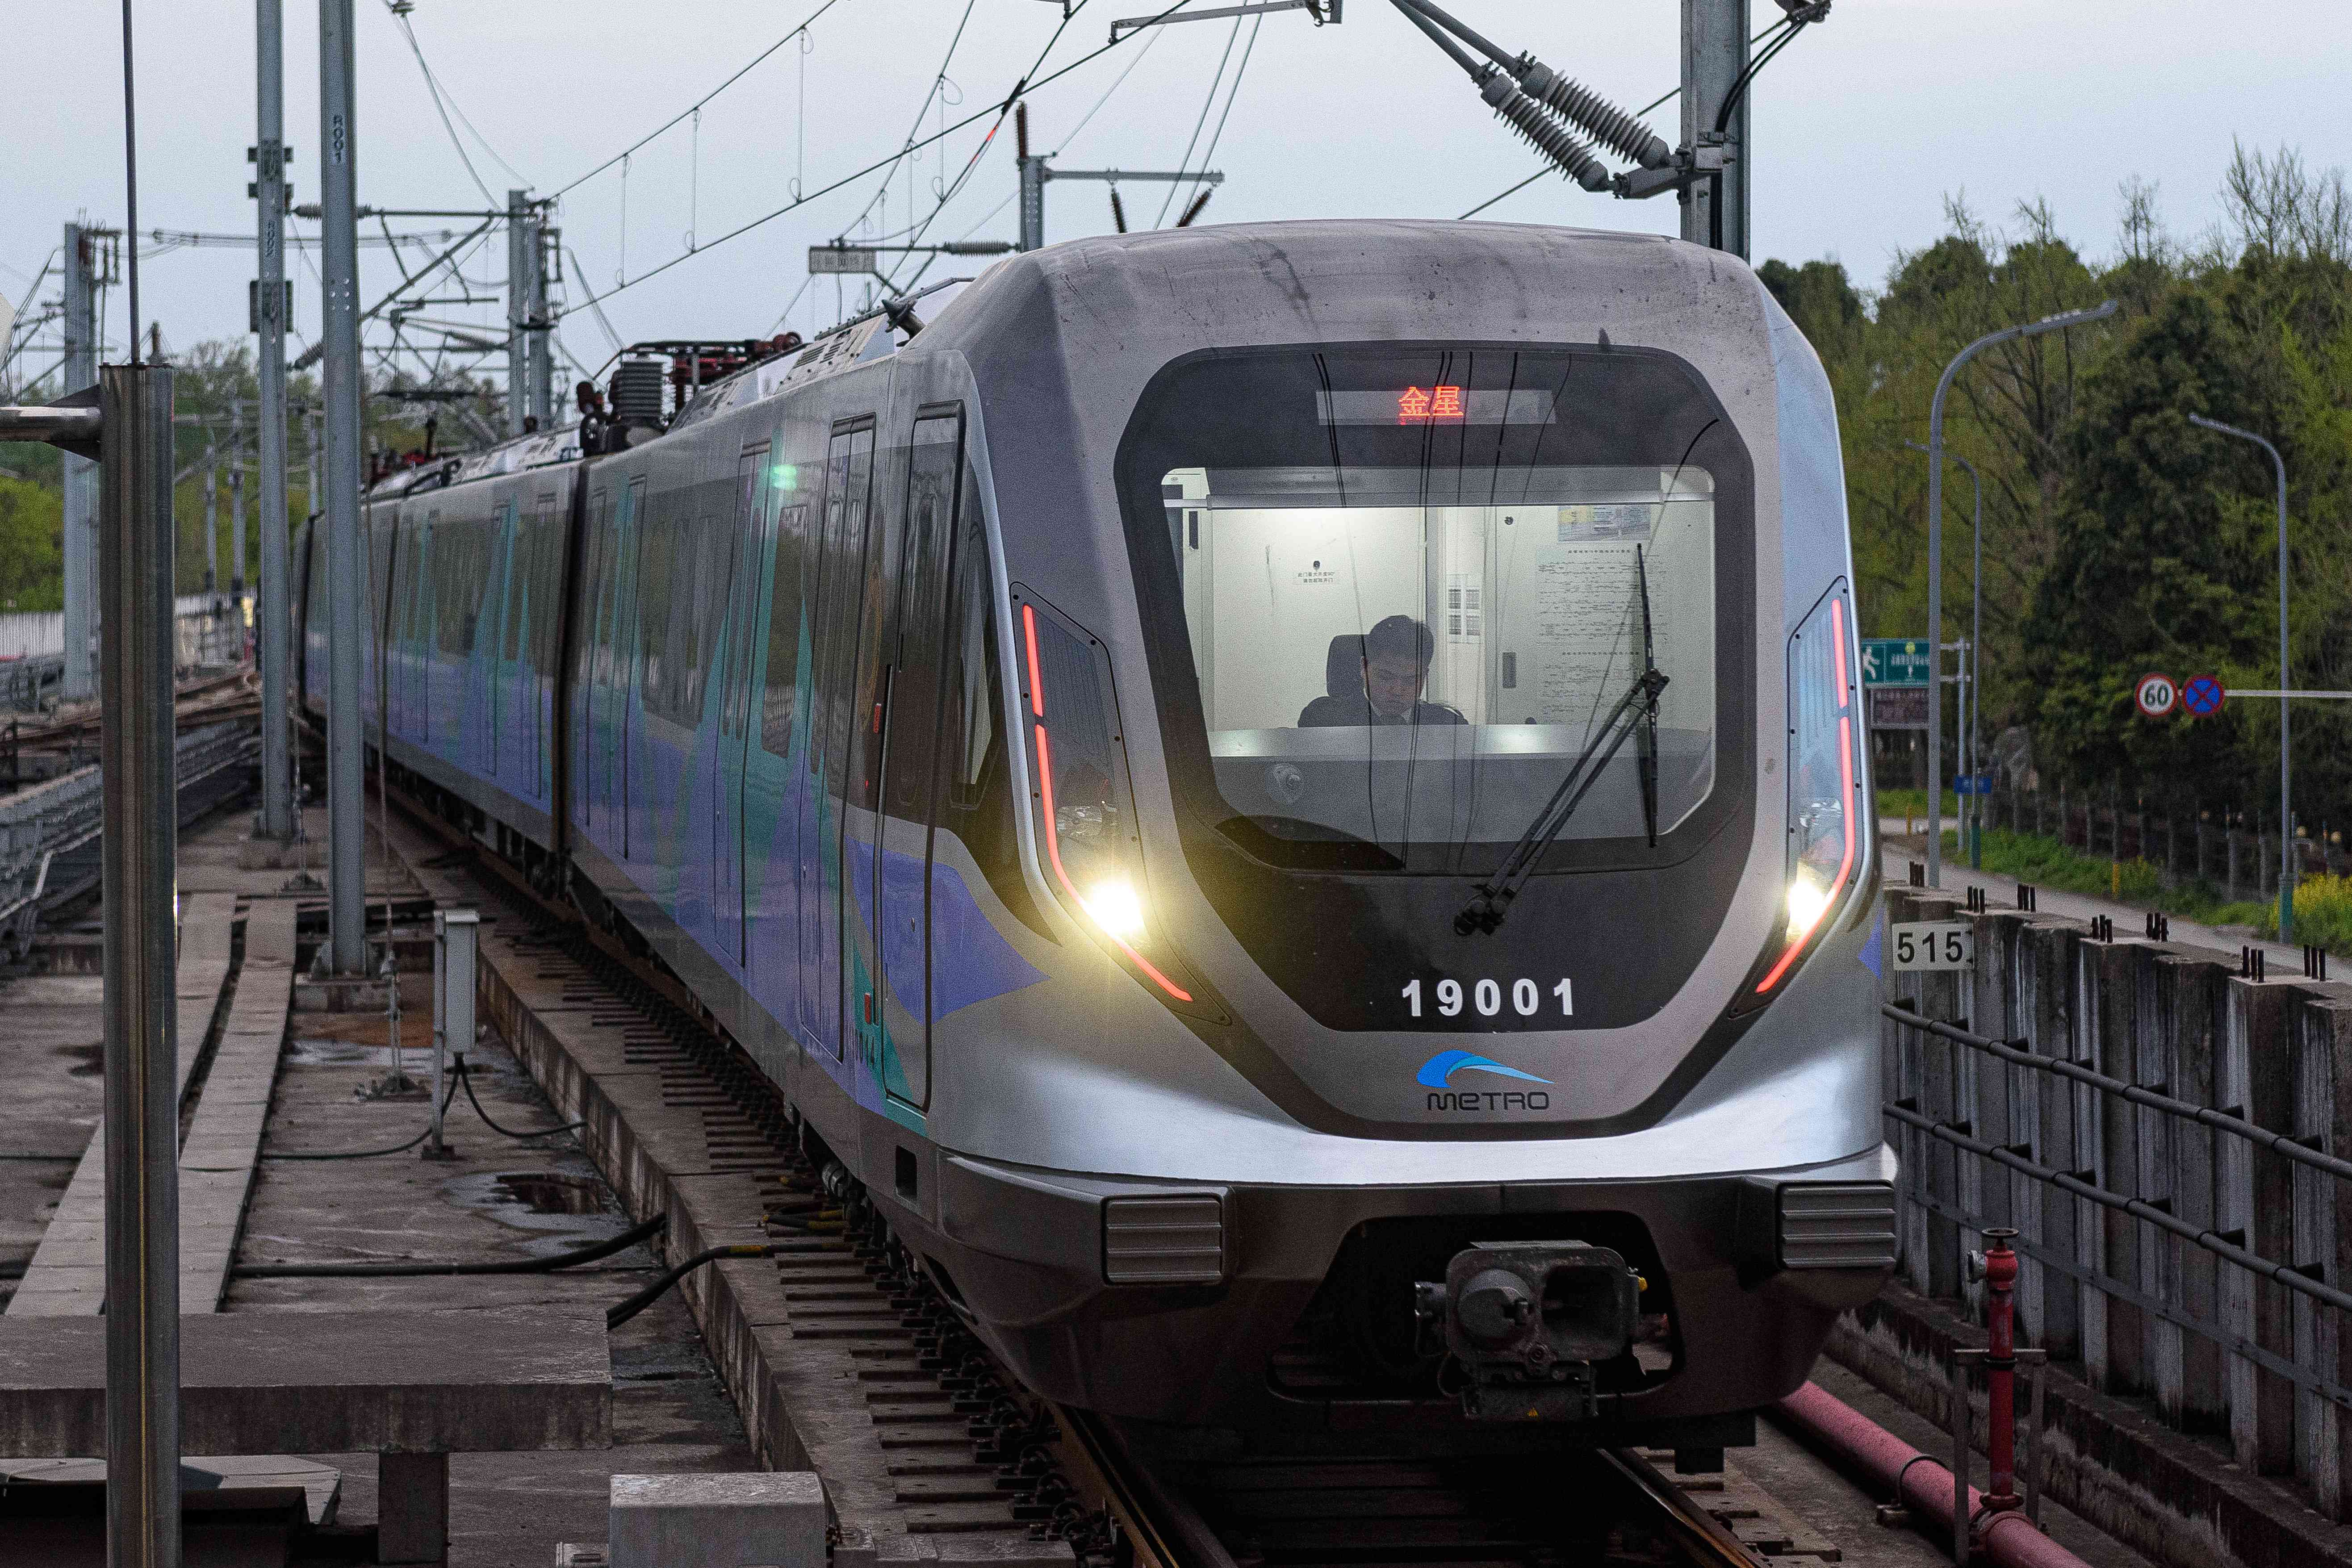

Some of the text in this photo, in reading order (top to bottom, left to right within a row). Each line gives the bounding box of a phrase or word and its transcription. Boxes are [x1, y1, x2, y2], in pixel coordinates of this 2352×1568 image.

[333, 114, 344, 163] R001
[1398, 386, 1464, 416] 金星
[2144, 684, 2168, 707] 60
[1897, 931, 1963, 963] 515
[1402, 978, 1573, 1017] 19001
